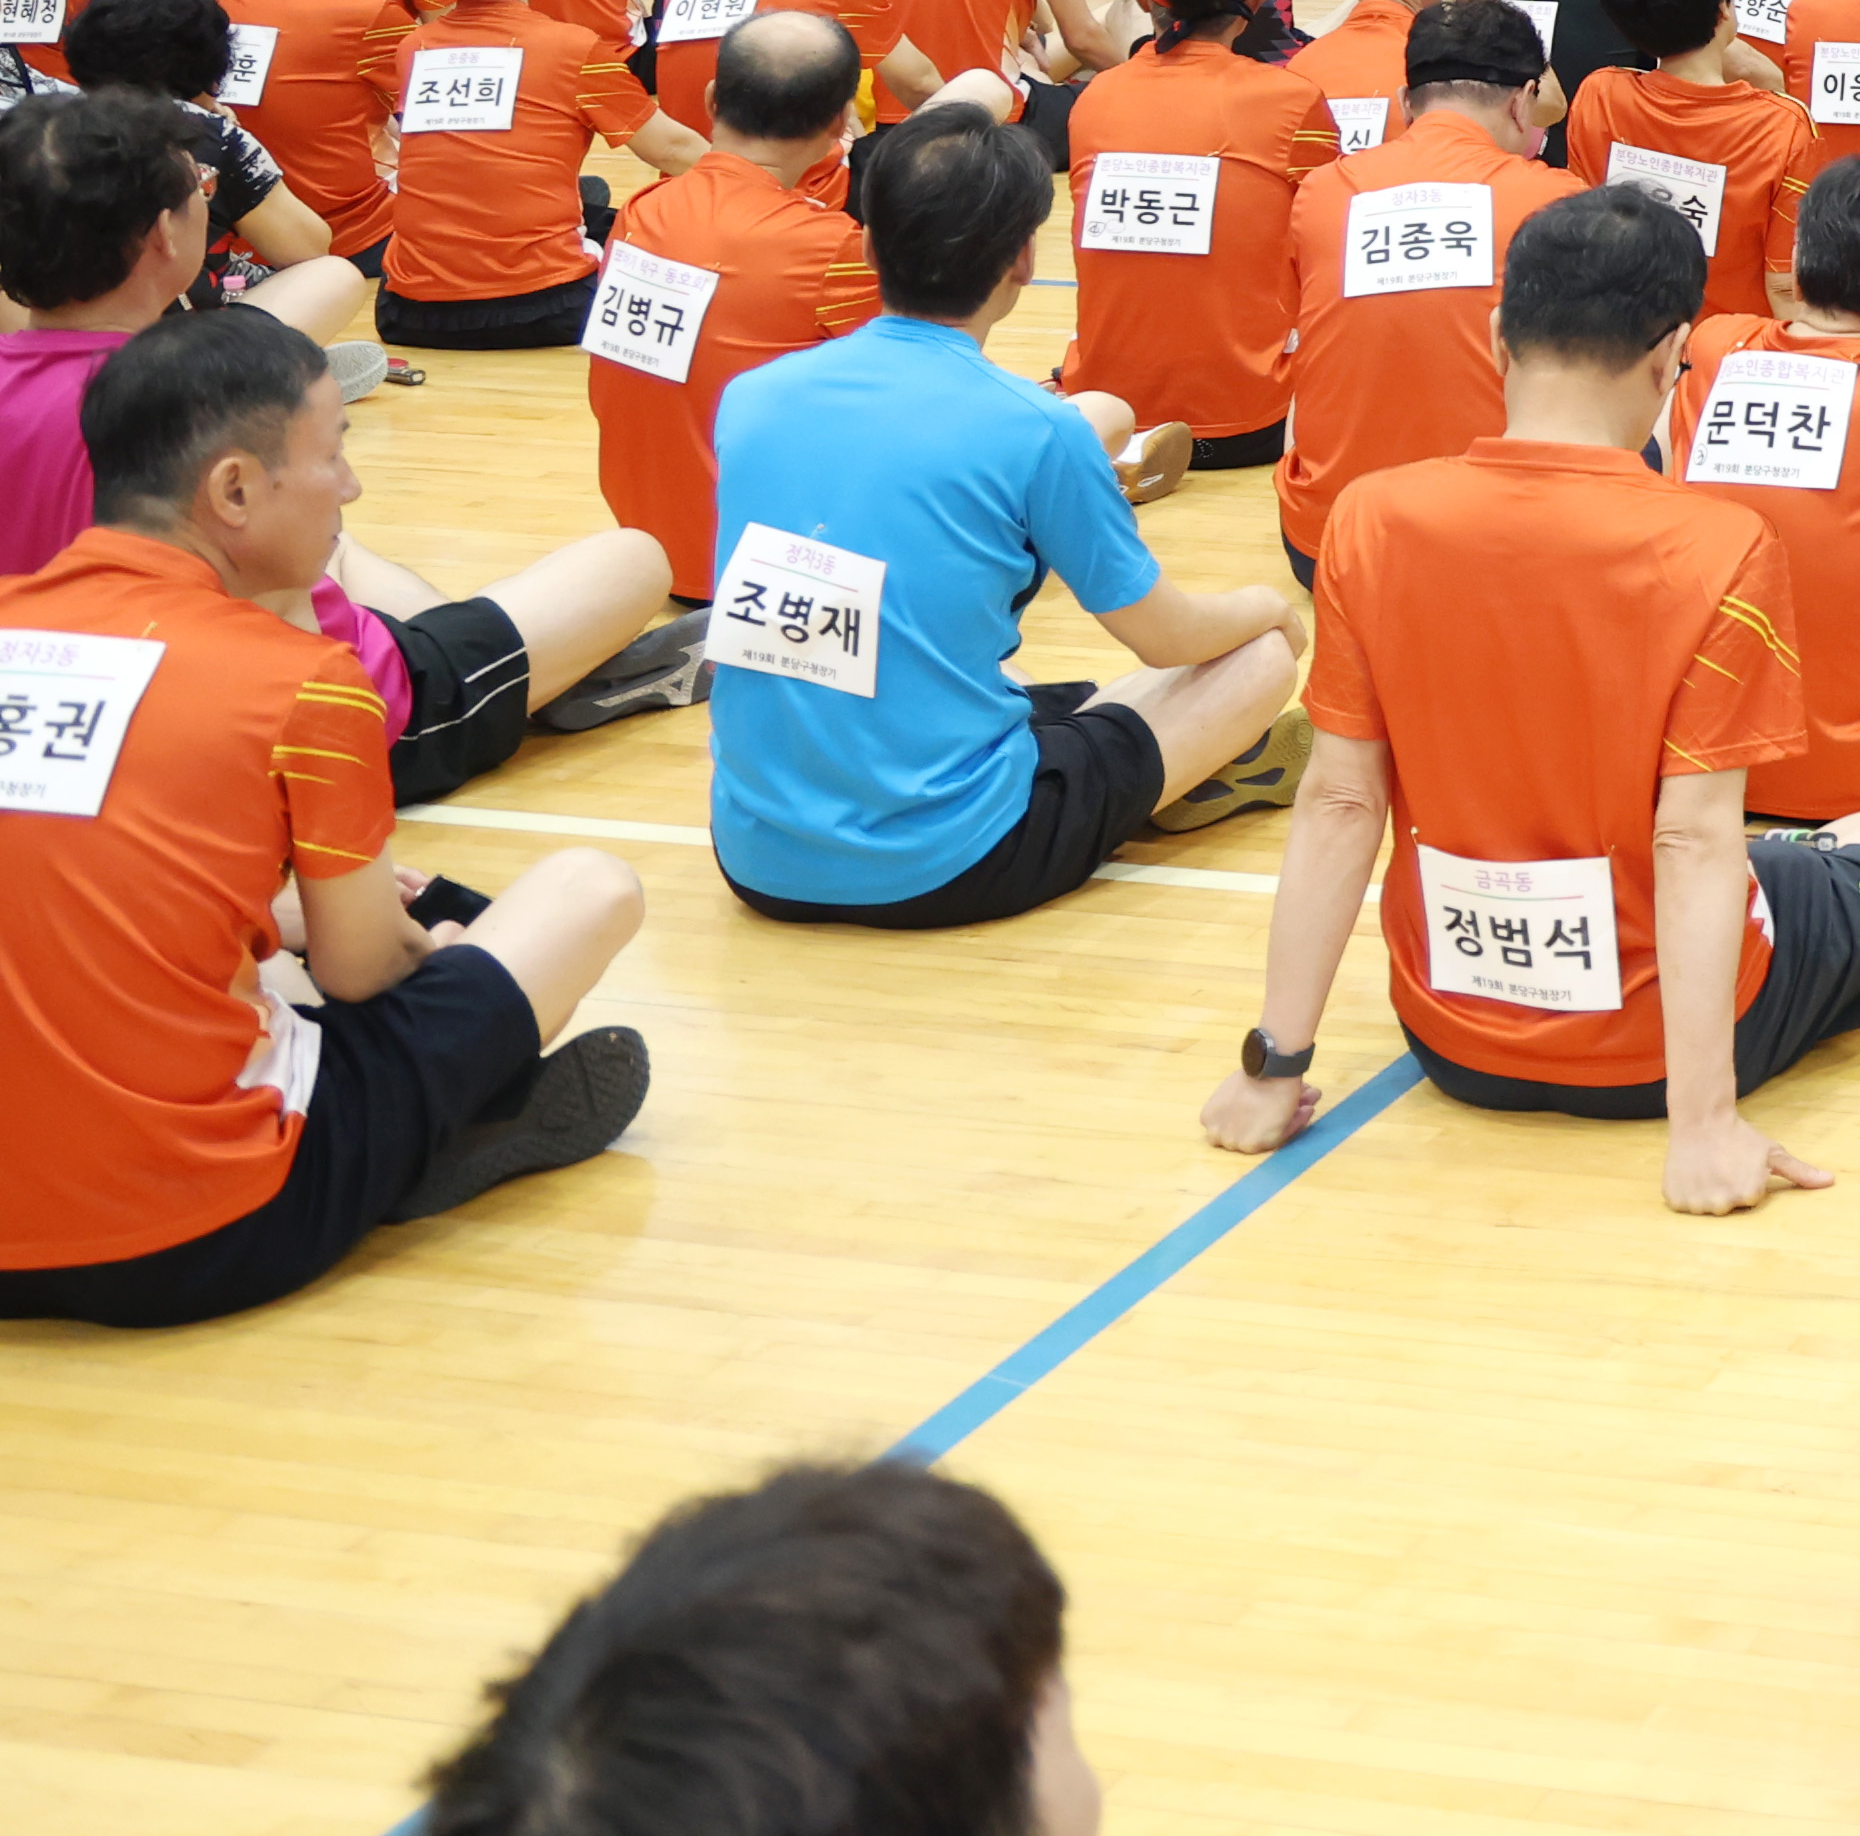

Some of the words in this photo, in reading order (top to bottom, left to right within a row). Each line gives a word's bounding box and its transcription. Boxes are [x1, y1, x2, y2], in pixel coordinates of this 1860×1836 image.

[415, 76, 505, 107] 조선희
[1100, 158, 1213, 176] 분당노인종합복지관
[1100, 188, 1200, 226] 박동근
[1391, 188, 1444, 206] 정자3동
[1360, 220, 1477, 265] 김종욱
[1407, 271, 1458, 284] 분당구청장기
[600, 285, 685, 347] 김병규
[1707, 400, 1831, 454] 문덕찬
[1713, 462, 1740, 475] 제19회
[1744, 463, 1801, 480] 분당구청장기
[786, 542, 835, 575] 정자3동
[726, 577, 860, 655] 조병재
[742, 646, 776, 664] 제19회
[780, 655, 838, 682] 분당구청장기
[0, 693, 106, 761] 홍권
[1474, 868, 1534, 893] 금곡동
[1442, 904, 1593, 972] 정범석
[1471, 975, 1505, 993] 제19회
[1509, 982, 1573, 1003] 분당구청장기
